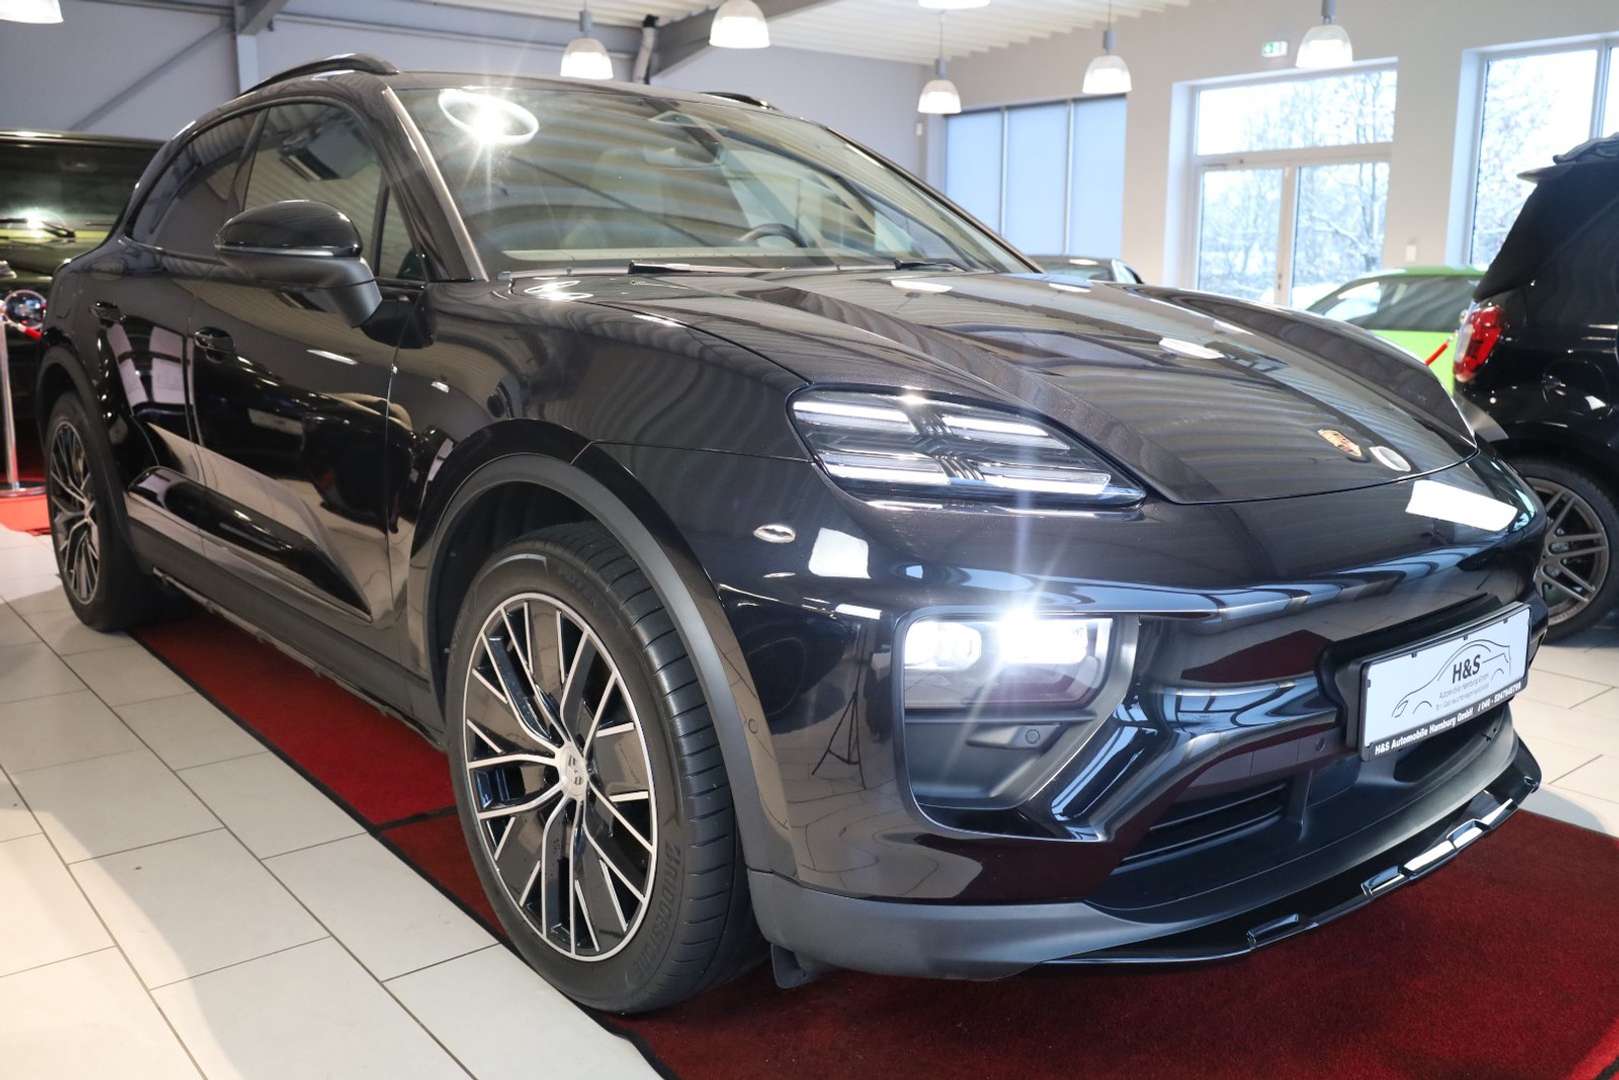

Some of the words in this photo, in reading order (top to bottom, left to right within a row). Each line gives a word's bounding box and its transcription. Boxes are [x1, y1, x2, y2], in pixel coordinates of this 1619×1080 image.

[1452, 654, 1480, 684] H&S
[1374, 742, 1390, 756] H&S
[1391, 728, 1428, 750] Automobile
[1429, 716, 1457, 735] Hamburg
